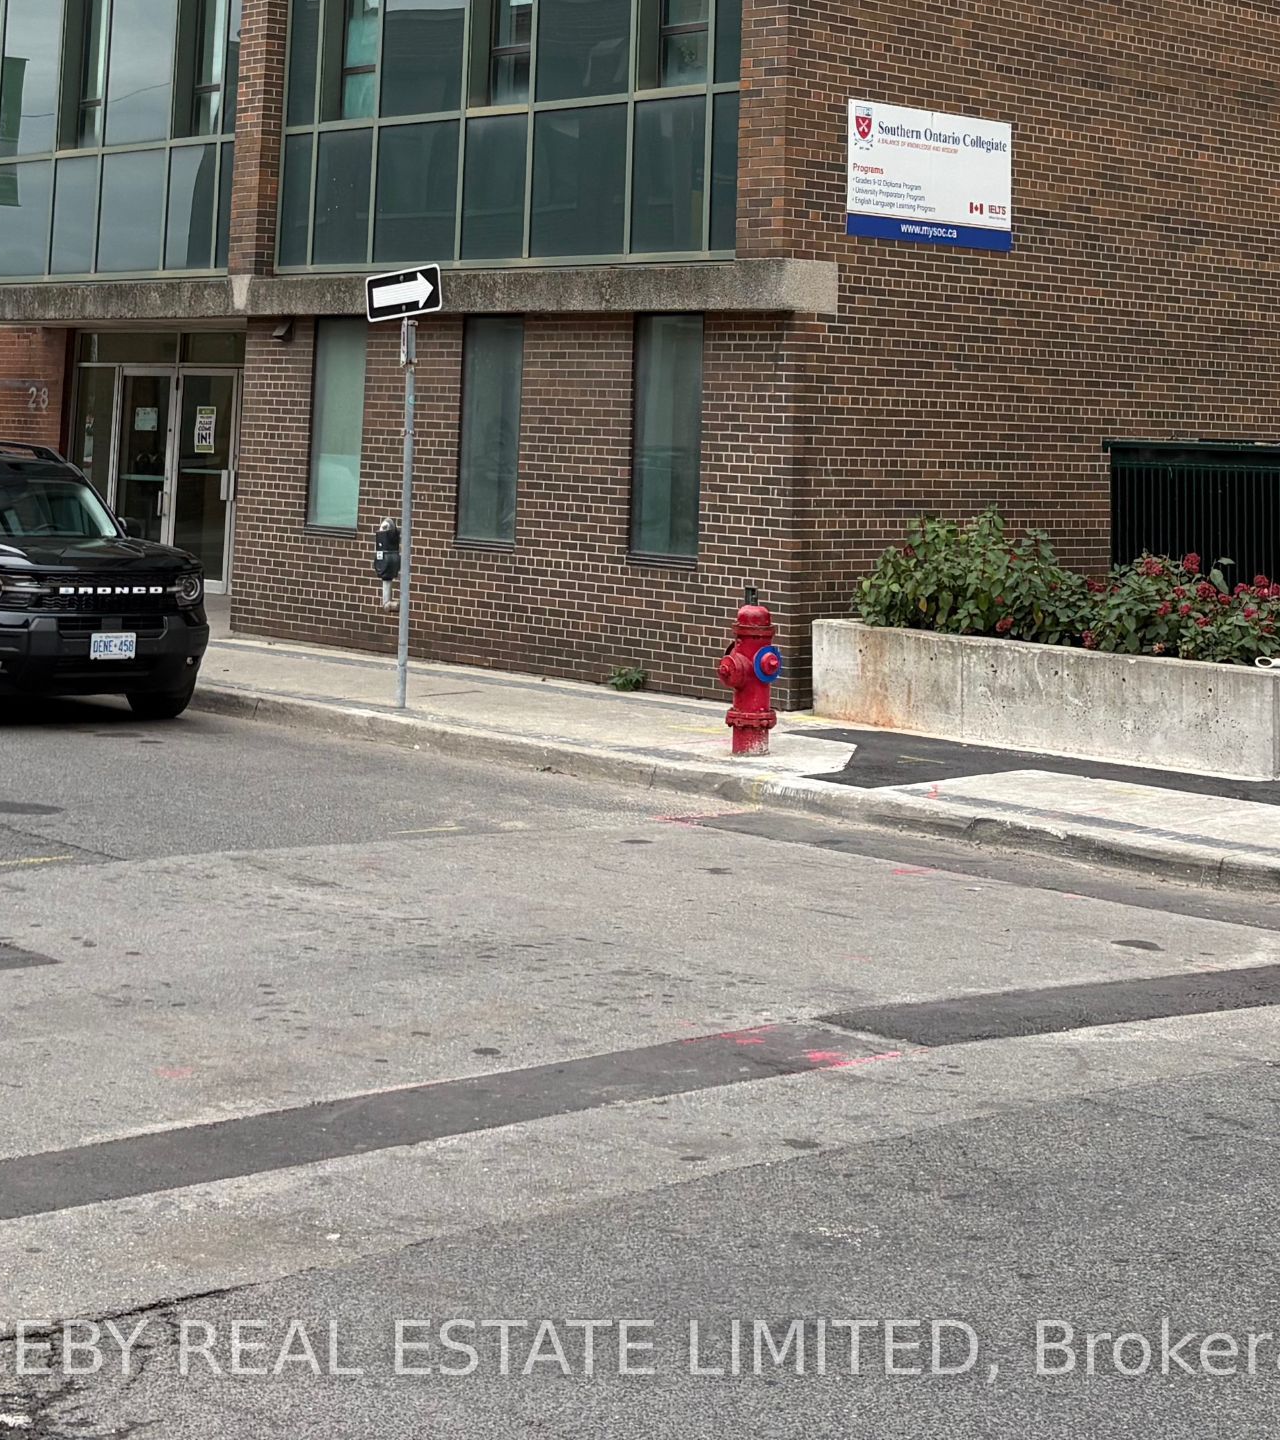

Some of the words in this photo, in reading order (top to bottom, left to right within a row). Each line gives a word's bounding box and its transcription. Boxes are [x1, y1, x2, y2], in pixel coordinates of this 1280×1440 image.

[878, 120, 922, 139] Southern
[924, 127, 961, 146] Ontario
[962, 133, 1008, 153] Collegiate
[852, 162, 884, 174] Programs
[855, 176, 872, 185] Grades
[883, 179, 902, 188] Diploma
[902, 182, 922, 191] Program
[855, 187, 878, 197] University
[906, 193, 926, 203] Program
[855, 196, 872, 206] English
[872, 199, 895, 209] Language
[916, 205, 936, 213] Program
[988, 204, 1007, 215] IELTS
[900, 223, 958, 239] www.mysoc.ca
[27, 386, 49, 409] 28
[197, 432, 211, 444] IN!
[93, 639, 113, 653] DENE
[118, 639, 134, 652] 458
